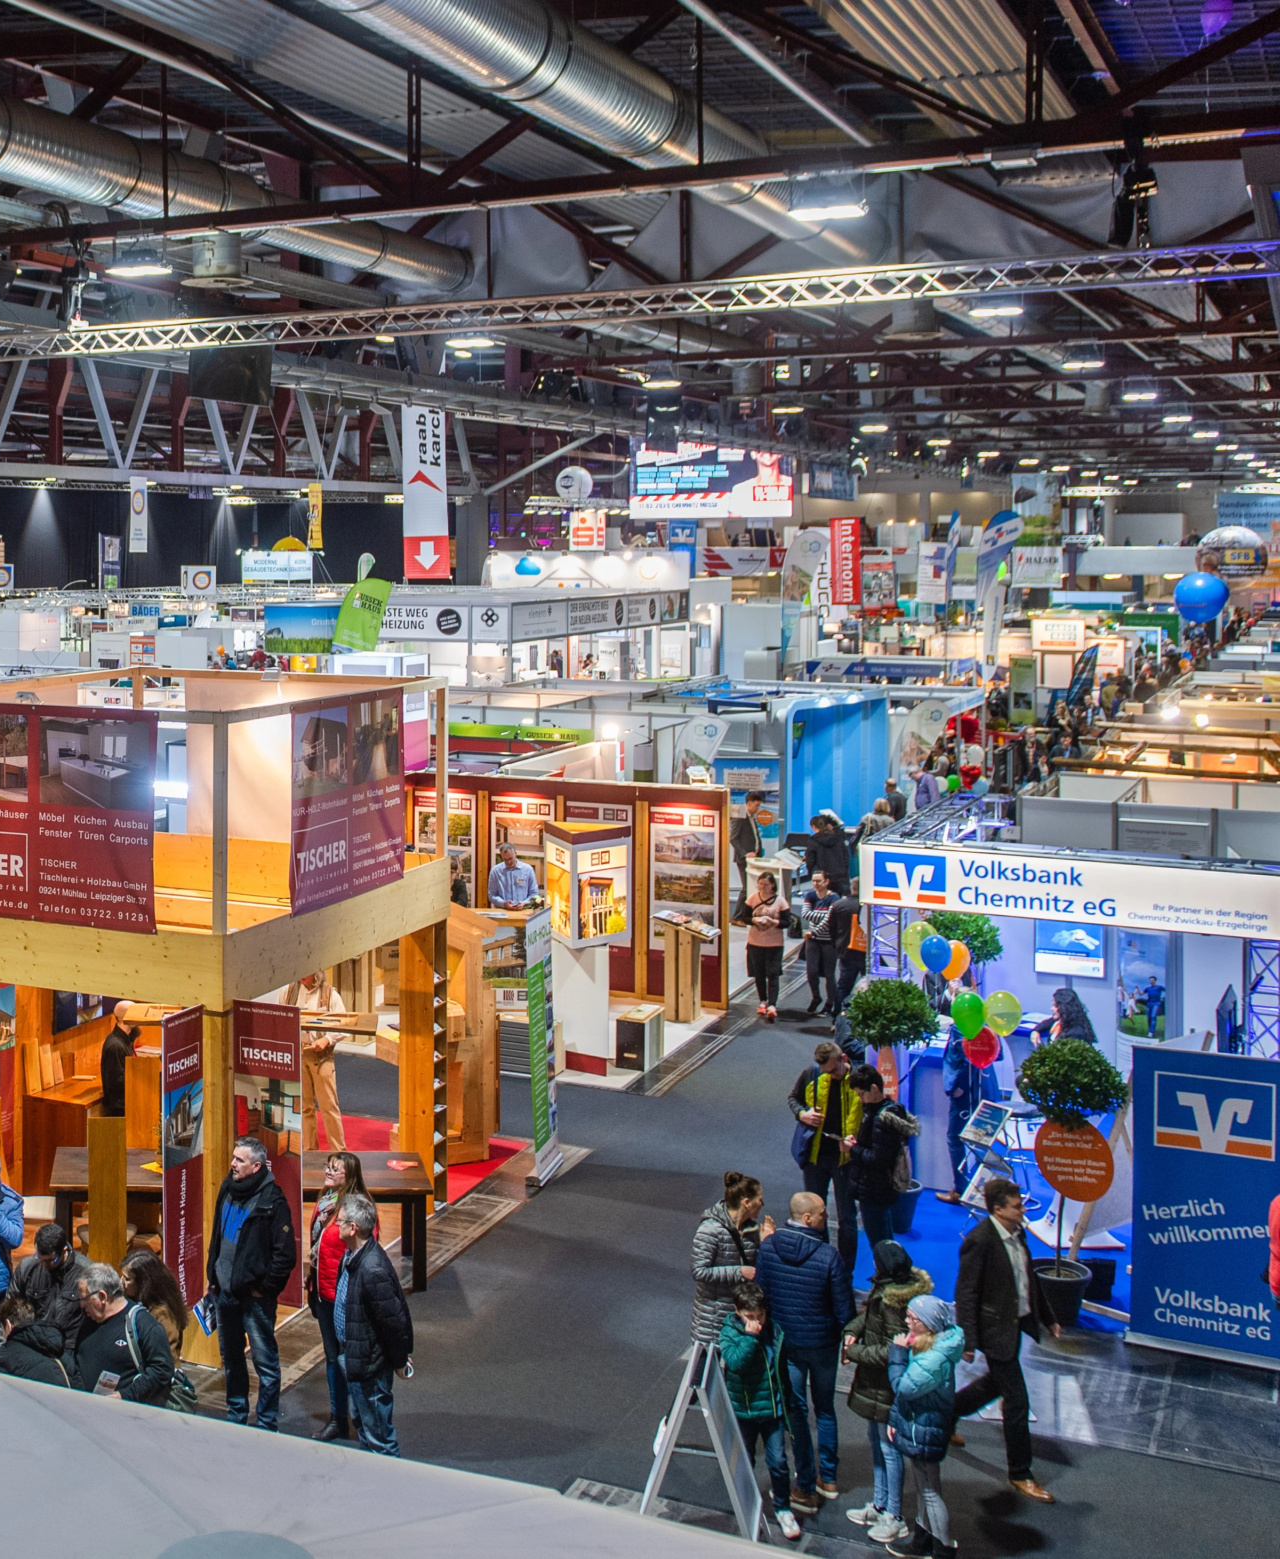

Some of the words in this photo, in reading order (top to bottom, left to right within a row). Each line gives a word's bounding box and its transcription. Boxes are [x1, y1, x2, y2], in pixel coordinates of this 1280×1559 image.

[416, 413, 427, 464] raab
[841, 519, 855, 602] Internorm
[1230, 552, 1251, 560] SFB
[132, 603, 160, 616] BÄDER
[360, 601, 382, 614] HAUS
[405, 608, 428, 618] WEG
[528, 608, 547, 618] elements
[570, 603, 578, 612] DER
[579, 601, 599, 612] EINFACHSTE
[600, 600, 609, 610] WEG
[381, 620, 425, 629] HEIZUNG
[570, 616, 578, 626] ZUR
[579, 615, 591, 625] NEUEN
[592, 612, 608, 623] HEIZUNG
[526, 732, 553, 740] GUSSEK
[560, 733, 580, 741] HAUS
[353, 793, 364, 802] Möbel
[367, 789, 383, 798] Küchen
[386, 784, 400, 793] Ausbau
[293, 798, 348, 817] NUR-HOLZ-Wohnhäuser
[353, 807, 368, 816] Fenster
[369, 802, 382, 810] Türen
[384, 797, 400, 808] Carports
[39, 812, 65, 823] Möbel
[74, 814, 107, 826] Küchen
[114, 818, 148, 830] Ausbau
[39, 828, 72, 839] Fenster
[78, 831, 105, 841] Türen
[109, 833, 148, 846] Carports
[353, 833, 371, 844] TISCHER
[388, 837, 401, 845] GmbH
[39, 859, 77, 870] TISCHER
[297, 840, 346, 874] TISCHER
[39, 872, 78, 884] Tischlerei
[87, 878, 122, 888] Holzbau
[123, 882, 147, 891] GmbH
[353, 874, 370, 886] Telefon
[371, 864, 400, 879] 03722.91291
[958, 859, 1083, 887] Volksbank
[39, 886, 60, 896] 09241
[62, 888, 87, 899] Mühlau
[90, 892, 125, 904] Leipziger
[295, 883, 348, 906] www.feineholzwerke.de
[957, 886, 1075, 915] Chemnitz
[1083, 898, 1117, 917] eG
[39, 903, 76, 914] Telefon
[80, 907, 149, 923] 03722.91291
[1152, 903, 1165, 913] Ihr
[1168, 904, 1202, 915] Partner
[1205, 908, 1213, 916] in
[1216, 908, 1231, 917] der
[1234, 910, 1268, 921] Region
[1127, 912, 1268, 932] Chemnitz-Zwickau-Erzgebirge
[239, 1006, 294, 1018] www.feineholzwerke.de
[168, 1053, 198, 1075] TISCHER
[242, 1047, 292, 1064] TISCHER
[1142, 1198, 1226, 1220] Herzlich
[1154, 1286, 1272, 1322] Volksbank
[1154, 1307, 1240, 1336] Chemnitz
[1245, 1324, 1271, 1341] eG
